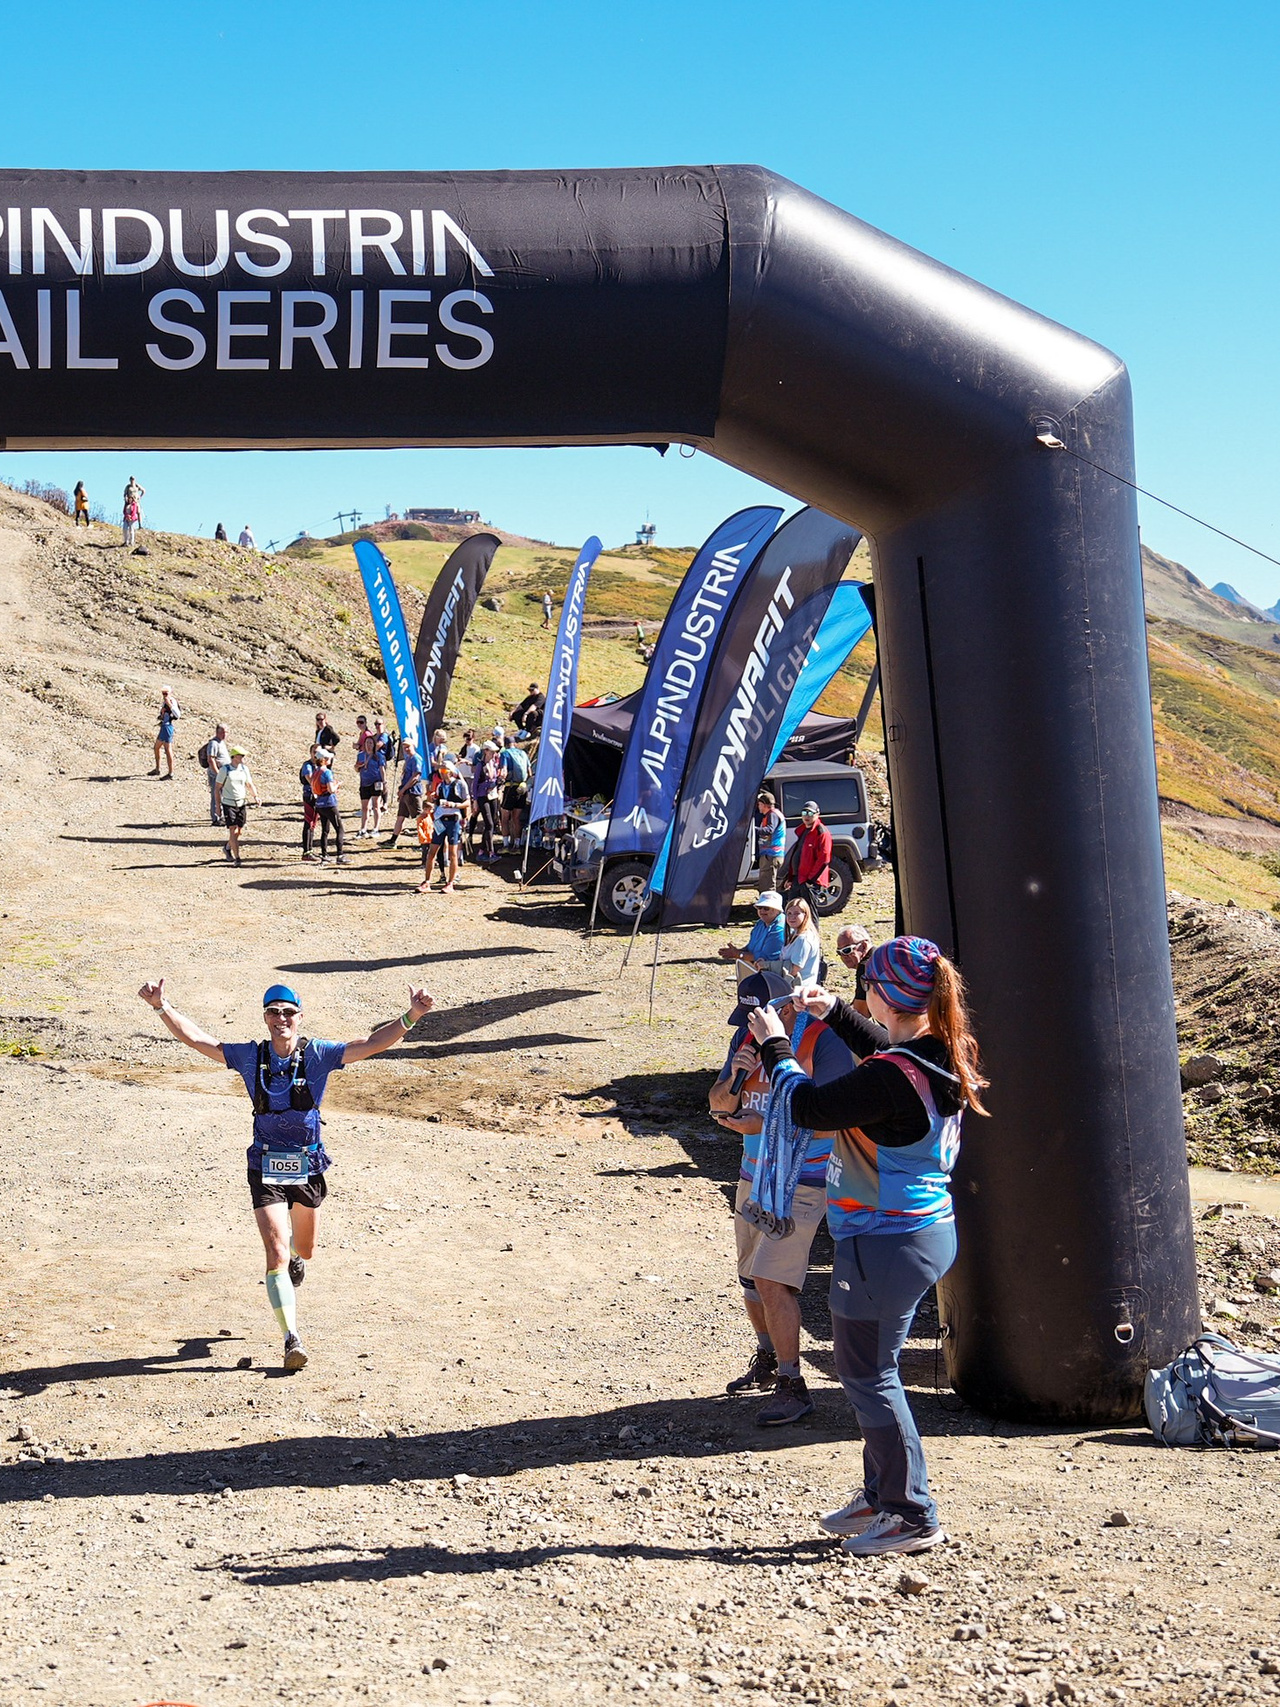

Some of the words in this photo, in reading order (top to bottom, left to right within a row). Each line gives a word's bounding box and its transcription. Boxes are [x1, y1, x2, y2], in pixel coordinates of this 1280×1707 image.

[145, 288, 495, 371] SERIES
[422, 567, 465, 694] DYNAFIT
[640, 541, 749, 789] ALPINDUSTRIA
[712, 566, 796, 807] DYNAFIT
[271, 1160, 299, 1172] 1055
